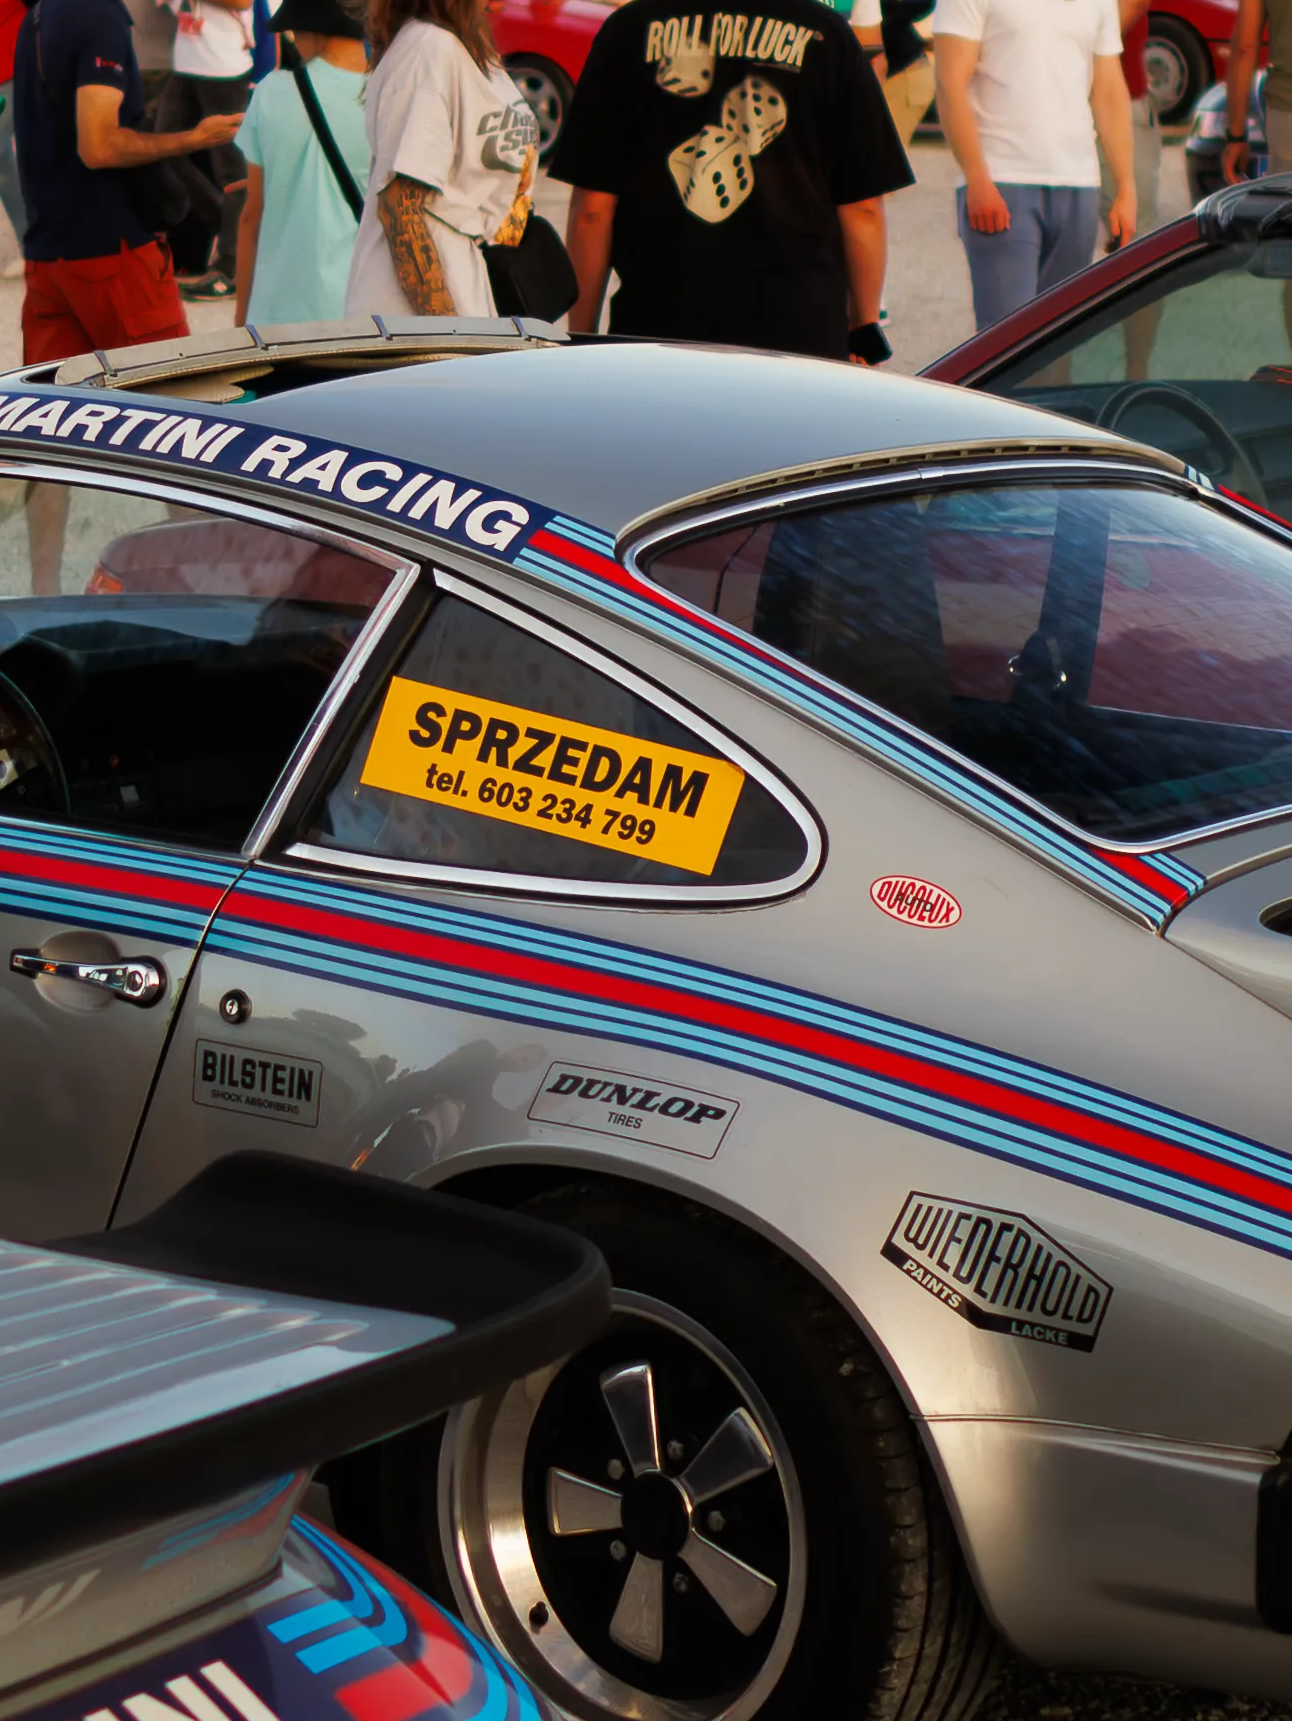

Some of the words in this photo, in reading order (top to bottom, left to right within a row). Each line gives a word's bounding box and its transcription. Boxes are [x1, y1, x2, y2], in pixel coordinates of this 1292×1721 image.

[645, 14, 703, 64] ROLL
[709, 11, 748, 58] FOR
[745, 16, 814, 67] LUCK
[240, 433, 531, 551] RACING
[408, 701, 710, 818] SPRZEDAM
[425, 762, 469, 798] tel.
[477, 776, 533, 813] 603
[536, 791, 593, 829] 234
[600, 807, 657, 846] 799
[201, 1048, 314, 1102] BILSTEIN
[210, 1088, 243, 1104] SHOCK
[244, 1095, 300, 1115] ABSORBERS
[545, 1073, 728, 1125] DUNLOP
[607, 1110, 643, 1129] TIRES
[902, 1258, 963, 1309] PAINTS
[903, 1202, 1101, 1325] WIEDERHOLD
[1010, 1321, 1070, 1346] LACKE
